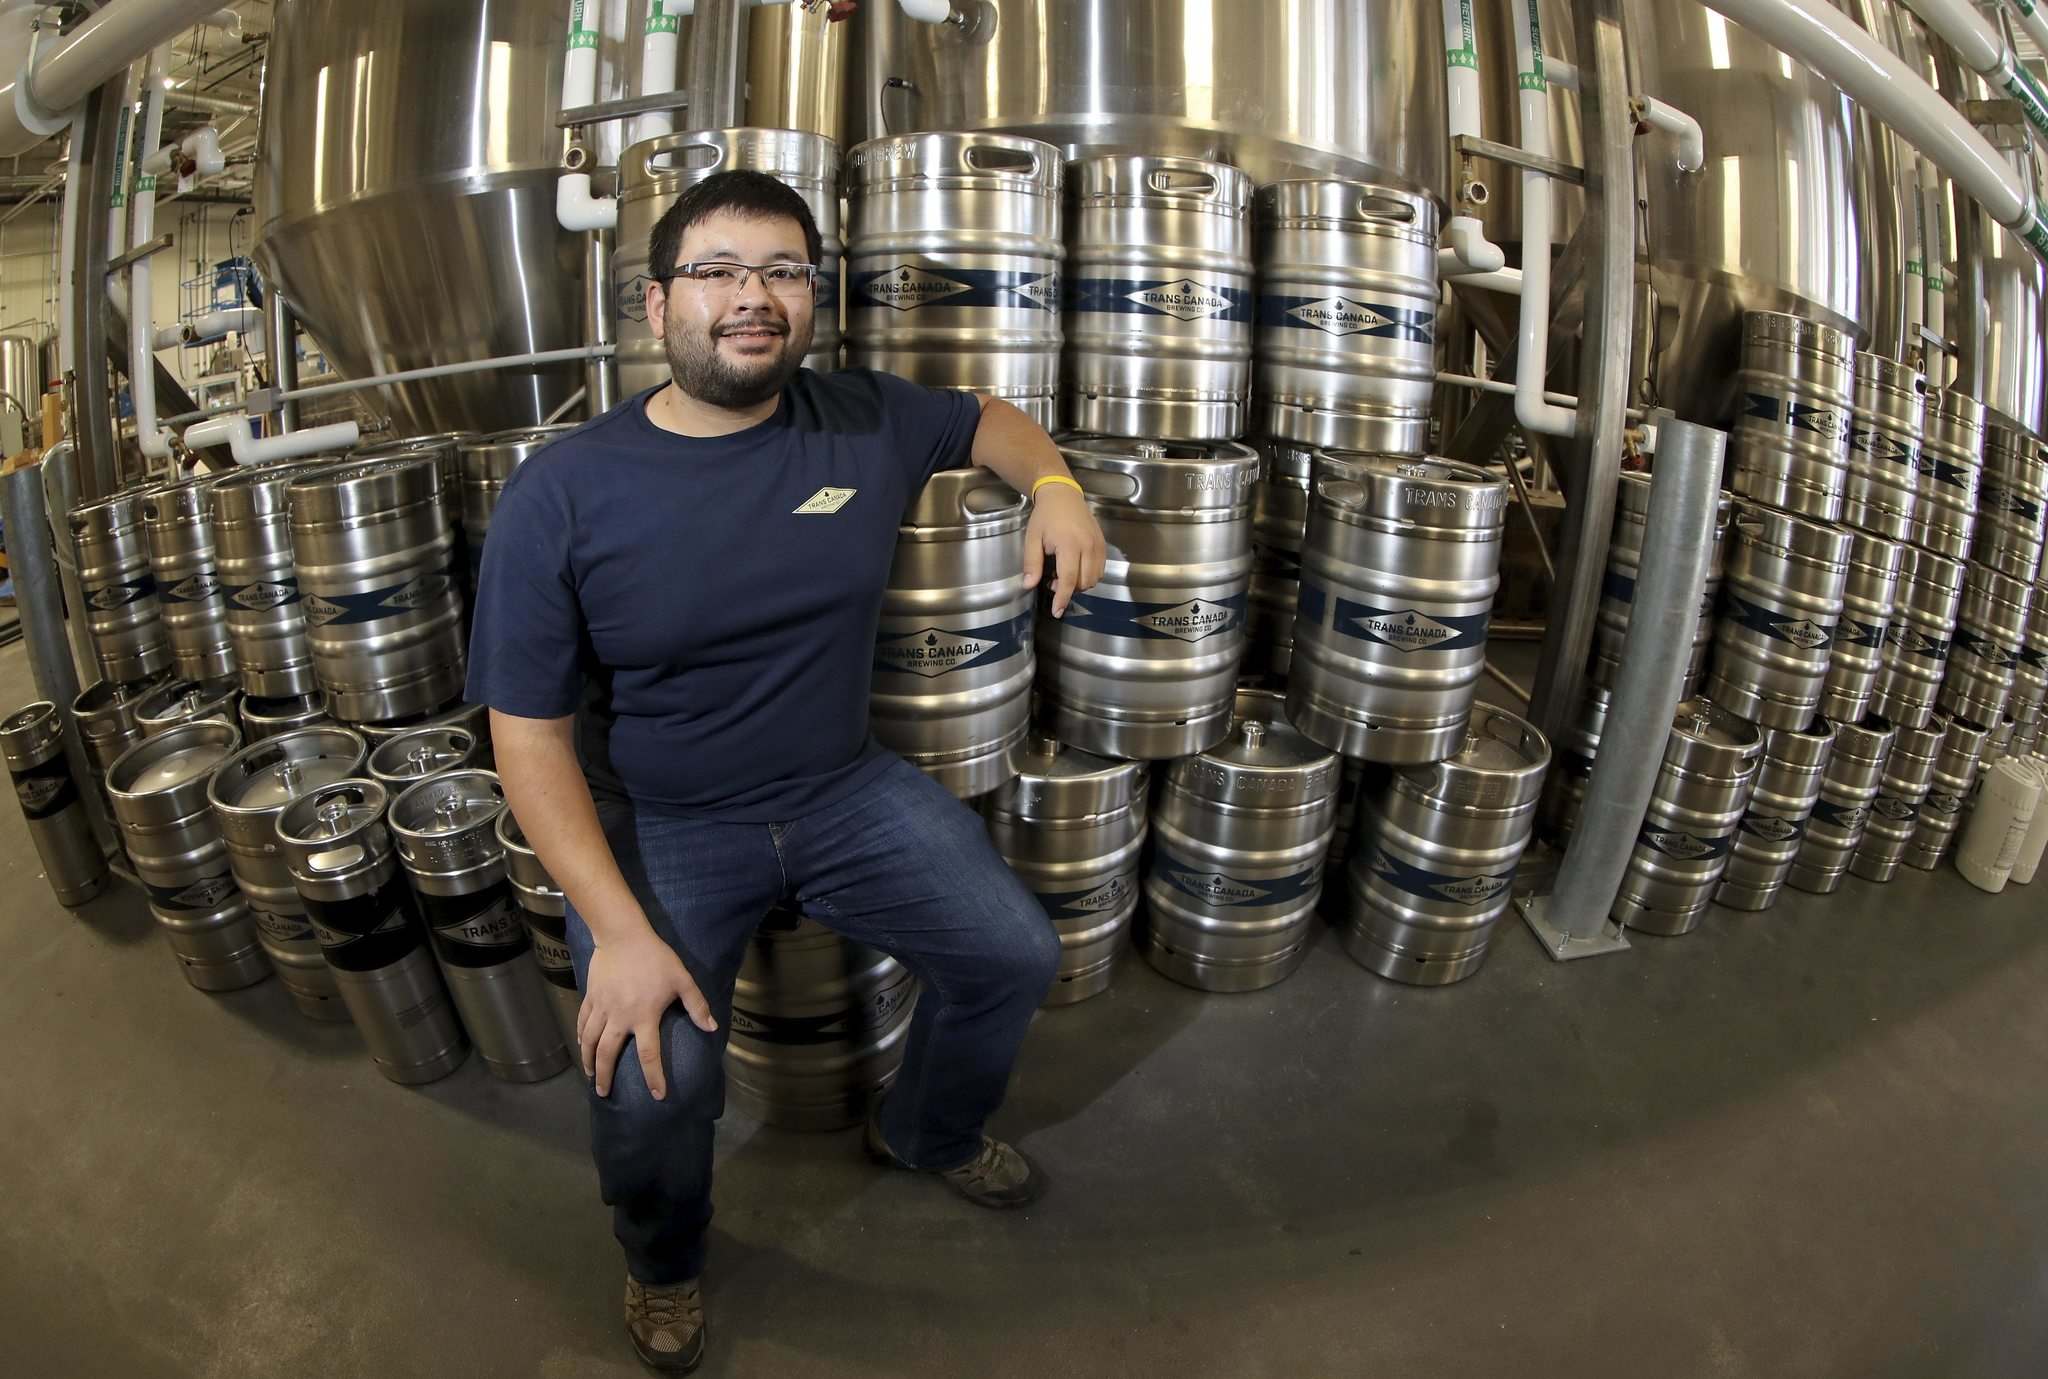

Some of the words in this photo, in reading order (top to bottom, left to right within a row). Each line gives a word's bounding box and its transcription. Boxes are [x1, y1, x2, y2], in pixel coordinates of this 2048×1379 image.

[1461, 2, 1472, 44] RETURN
[870, 282, 903, 293] TRANS
[902, 283, 950, 293] CANADA
[1029, 286, 1053, 297] TRANS
[1144, 293, 1180, 304] TRANS
[1184, 295, 1222, 308] CANADA
[1166, 304, 1195, 312] BREWING
[1300, 308, 1333, 320] TRANS
[1336, 312, 1378, 325] CANADA
[1185, 472, 1232, 490] TRANS
[808, 499, 827, 510] TRANS
[1405, 487, 1457, 509] TRANS
[1152, 616, 1189, 626] TRANS
[1192, 610, 1228, 625] CANADA
[1175, 626, 1203, 634] BREWING
[1368, 619, 1403, 634] TRANS
[1406, 626, 1447, 638] CANADA
[928, 643, 980, 658] CANADA
[907, 659, 944, 668] BREWING
[1213, 886, 1255, 897] CANADA
[1444, 885, 1472, 894] TRANS
[462, 917, 506, 938] TRANS
